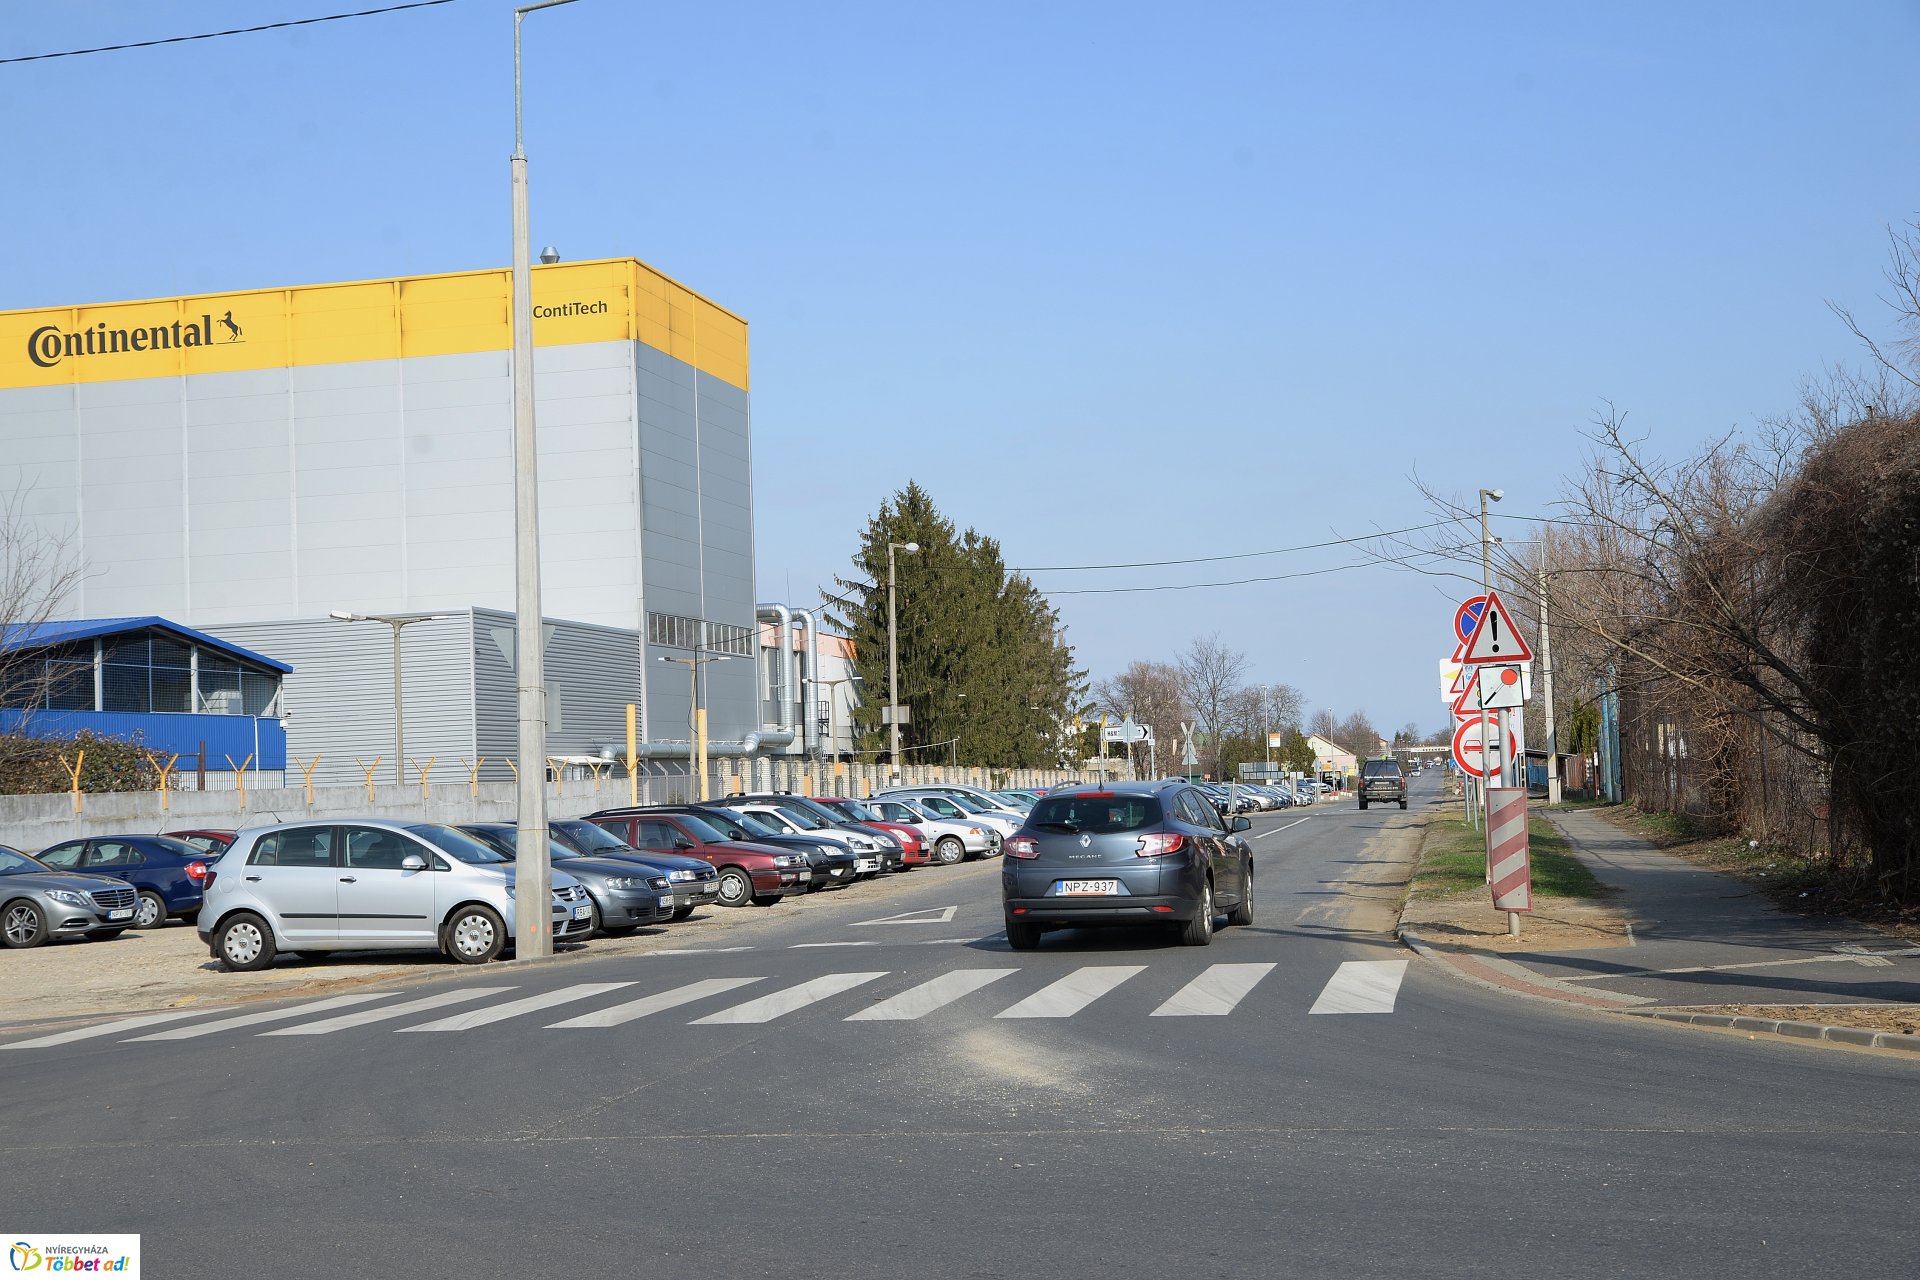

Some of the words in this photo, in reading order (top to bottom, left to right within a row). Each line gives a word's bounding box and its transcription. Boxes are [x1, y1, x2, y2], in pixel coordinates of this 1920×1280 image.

[533, 300, 608, 319] ContiTech
[27, 313, 214, 368] Continental
[1065, 881, 1115, 892] NPZ-937
